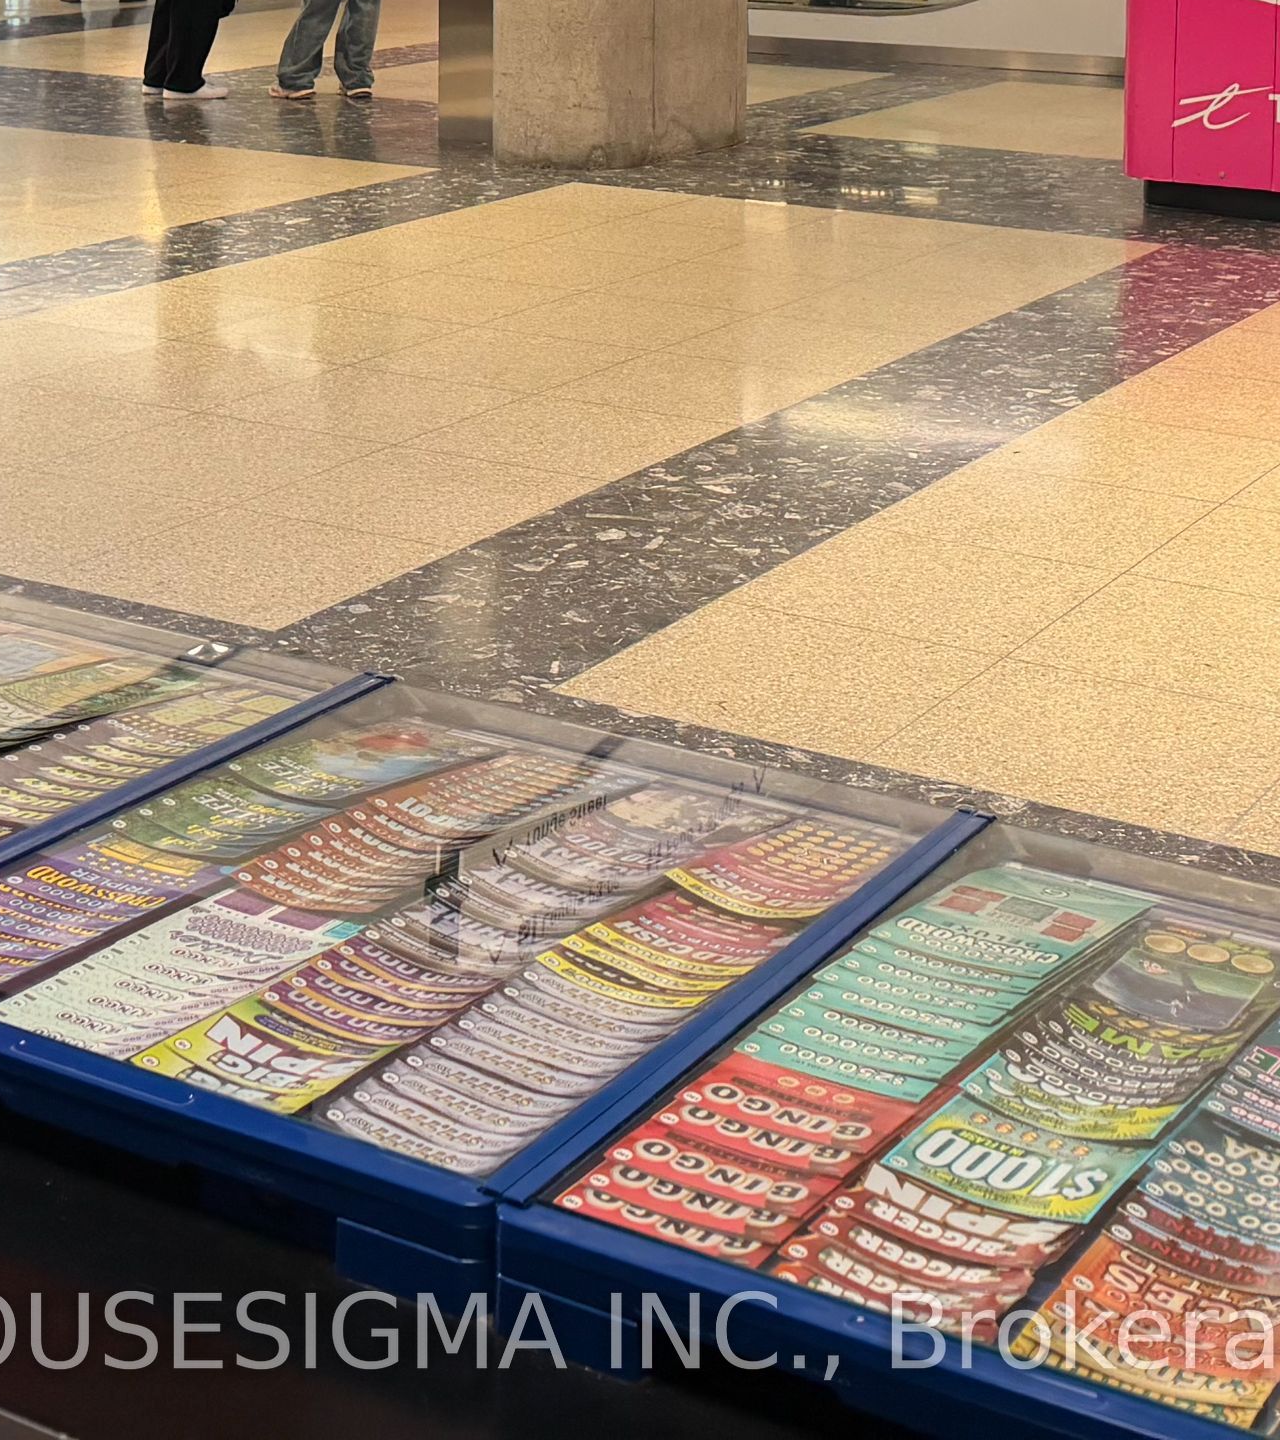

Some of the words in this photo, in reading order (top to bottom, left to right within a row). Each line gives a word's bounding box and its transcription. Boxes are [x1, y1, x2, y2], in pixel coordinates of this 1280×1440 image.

[25, 864, 168, 910] CROSSWORD
[70, 866, 154, 897] TRIPLER
[688, 866, 767, 903] CASH
[612, 918, 696, 962] CASH
[895, 915, 1063, 965] CROSSWORD
[216, 1054, 300, 1088] BIG
[704, 1082, 872, 1141] BINGO
[634, 1138, 809, 1203] BINGO
[848, 1224, 993, 1285] BIGGER
